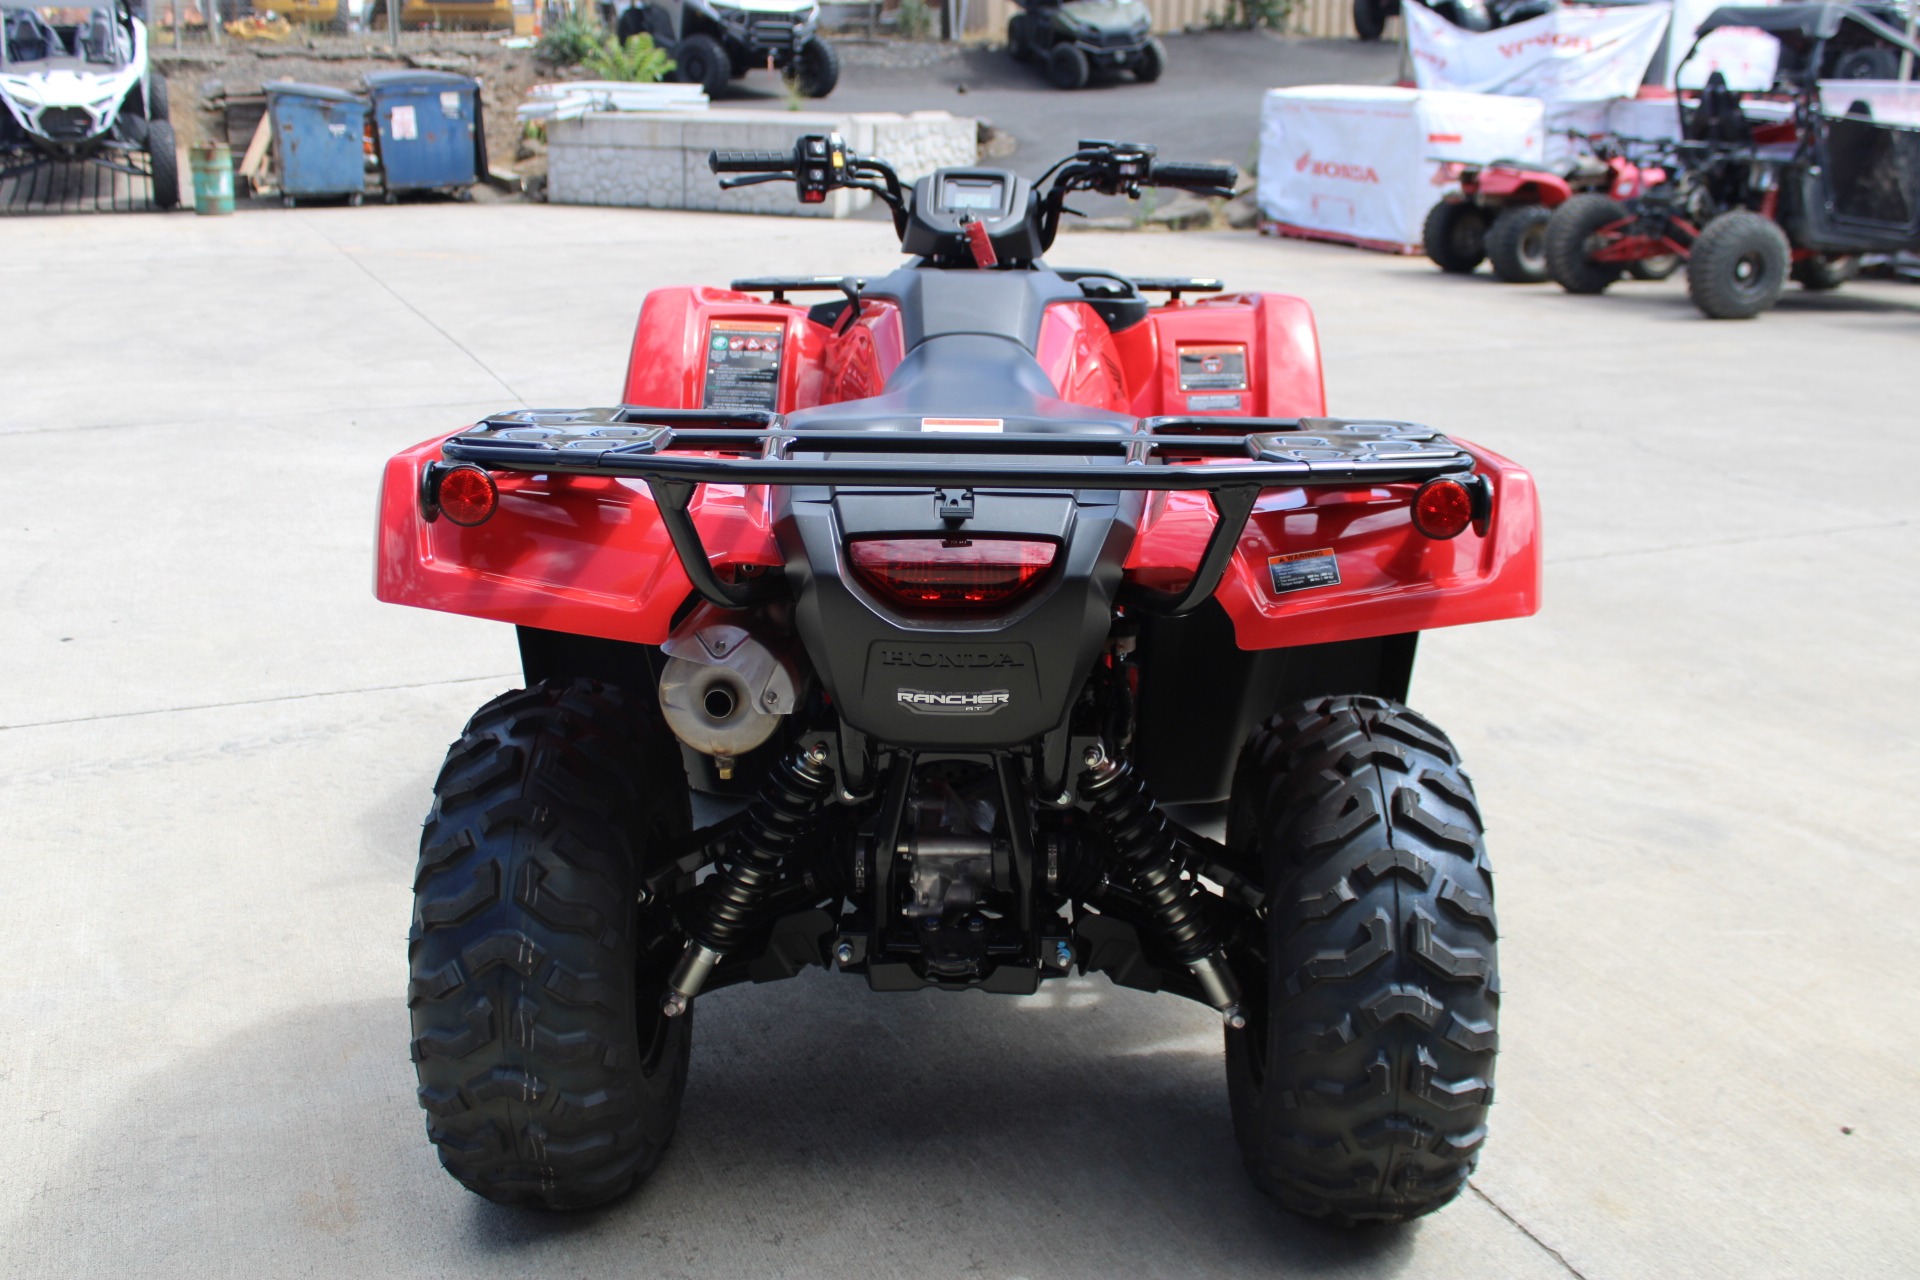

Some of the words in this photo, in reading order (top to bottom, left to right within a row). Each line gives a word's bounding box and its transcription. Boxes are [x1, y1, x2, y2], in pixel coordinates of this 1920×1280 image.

[1312, 160, 1380, 184] HONDA
[1287, 551, 1324, 561] WARNING
[882, 651, 1024, 668] HONDA
[897, 692, 1010, 704] RANCHER
